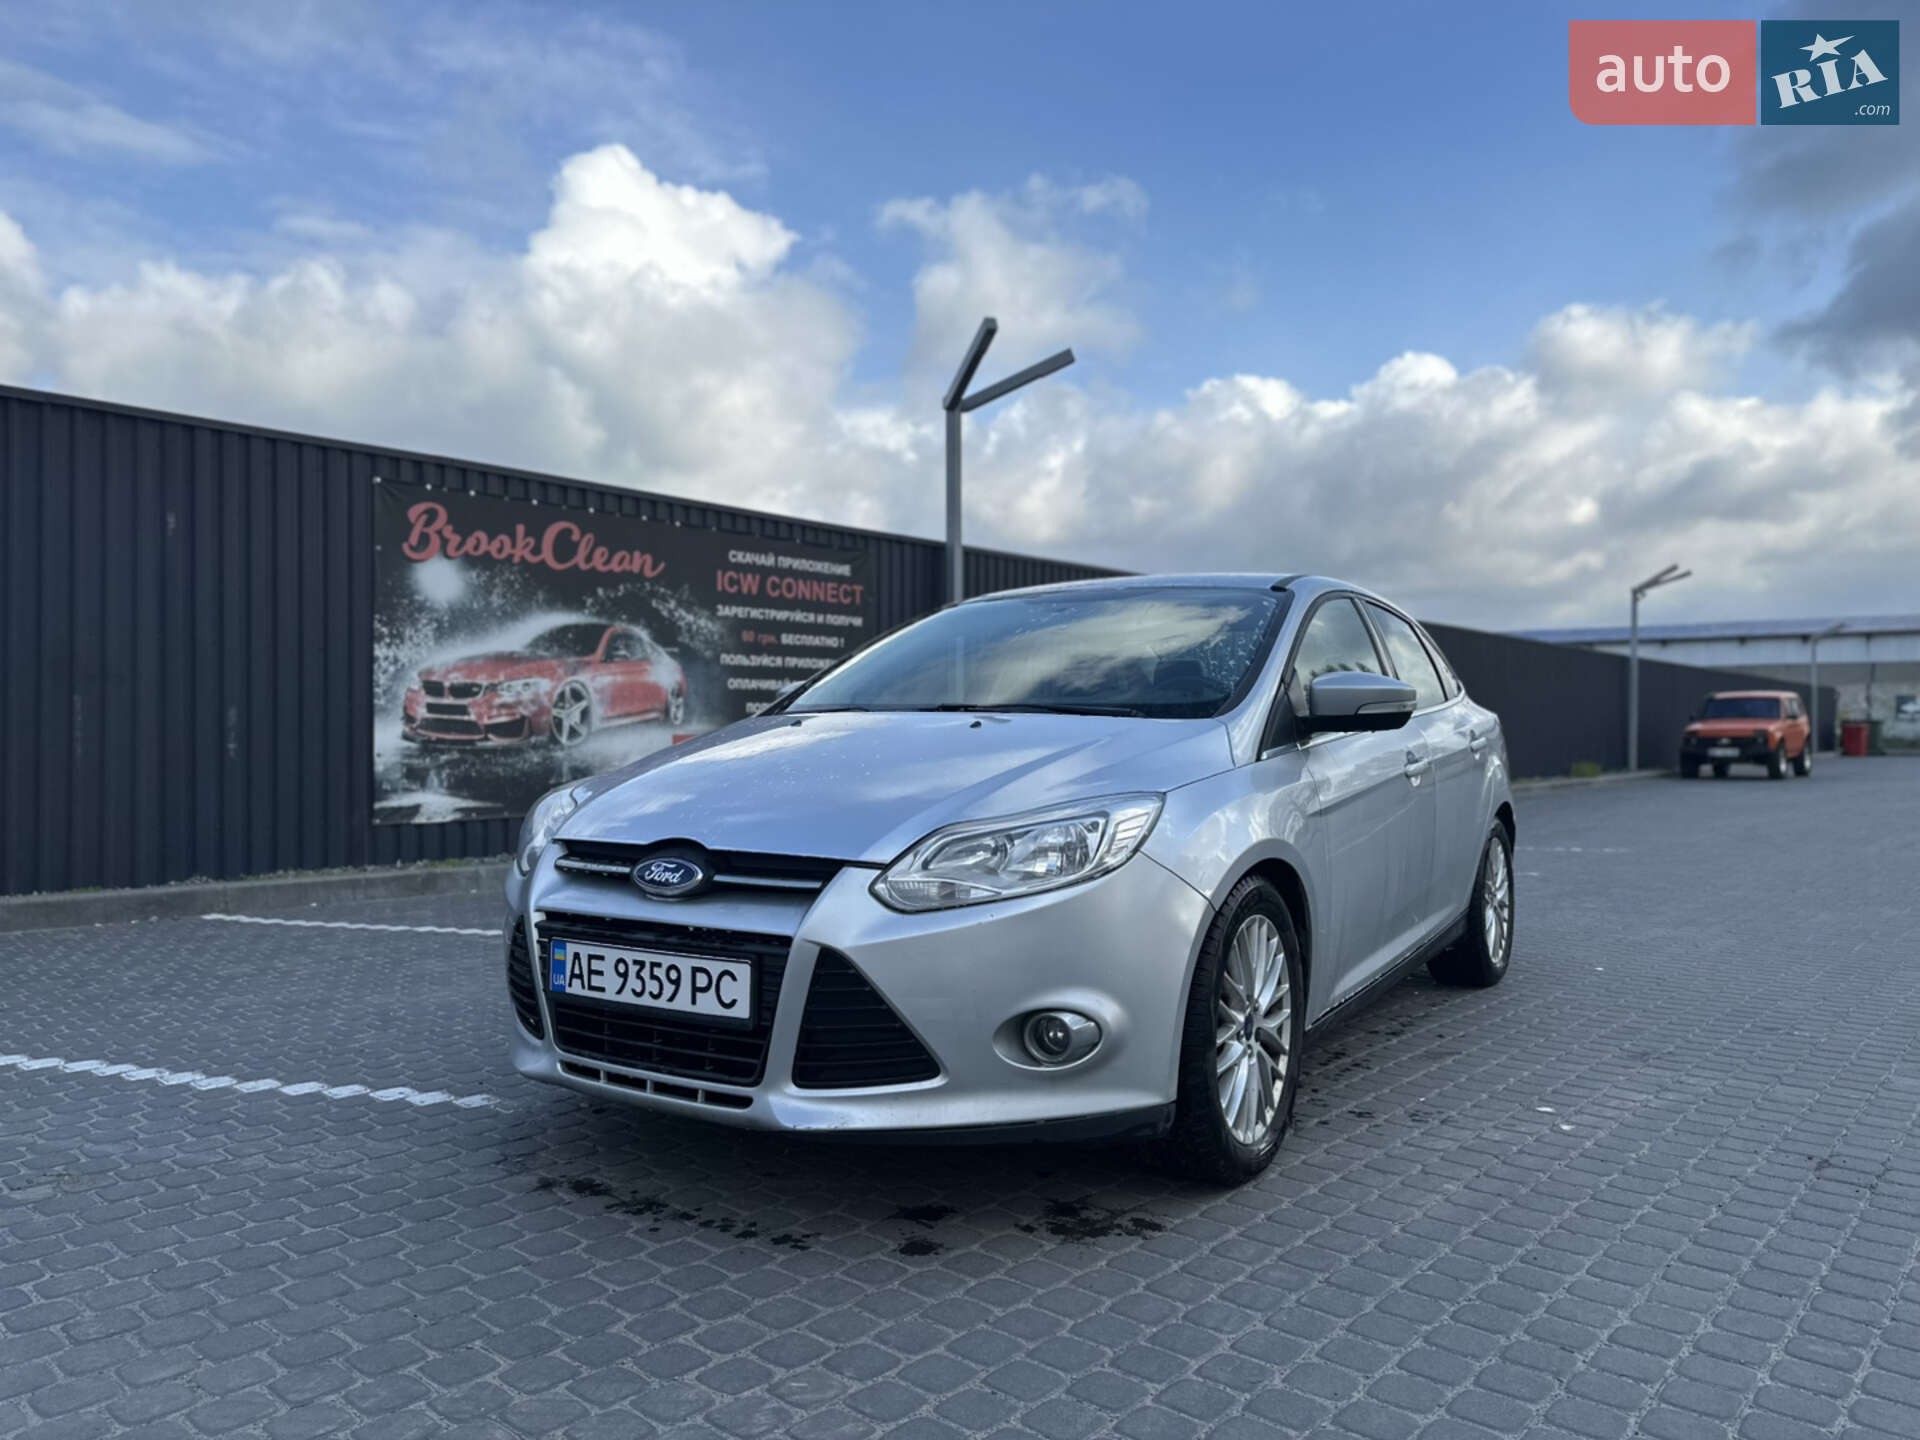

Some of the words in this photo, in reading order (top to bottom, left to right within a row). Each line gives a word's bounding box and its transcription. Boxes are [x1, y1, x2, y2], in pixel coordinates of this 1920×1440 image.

[402, 502, 665, 578] BrookClean
[728, 550, 775, 567] СКАЧАЙ
[778, 556, 851, 576] ПРИЛОЖЕНИЕ
[716, 569, 761, 596] ICW
[766, 575, 864, 606] CONNECT
[716, 604, 816, 624] ЗАРЕГИСТРИРУЙСЯ
[817, 615, 824, 624] И
[826, 615, 863, 627] ПОЛУЧИ
[780, 633, 840, 648] БЕСПЛАТНО
[720, 653, 782, 667] ПОЛЬЗУЙСЯ
[645, 862, 683, 883] Ford
[553, 973, 566, 985] UA
[568, 951, 606, 992] AE
[614, 957, 682, 1003] 9359
[691, 965, 738, 1010] PC
